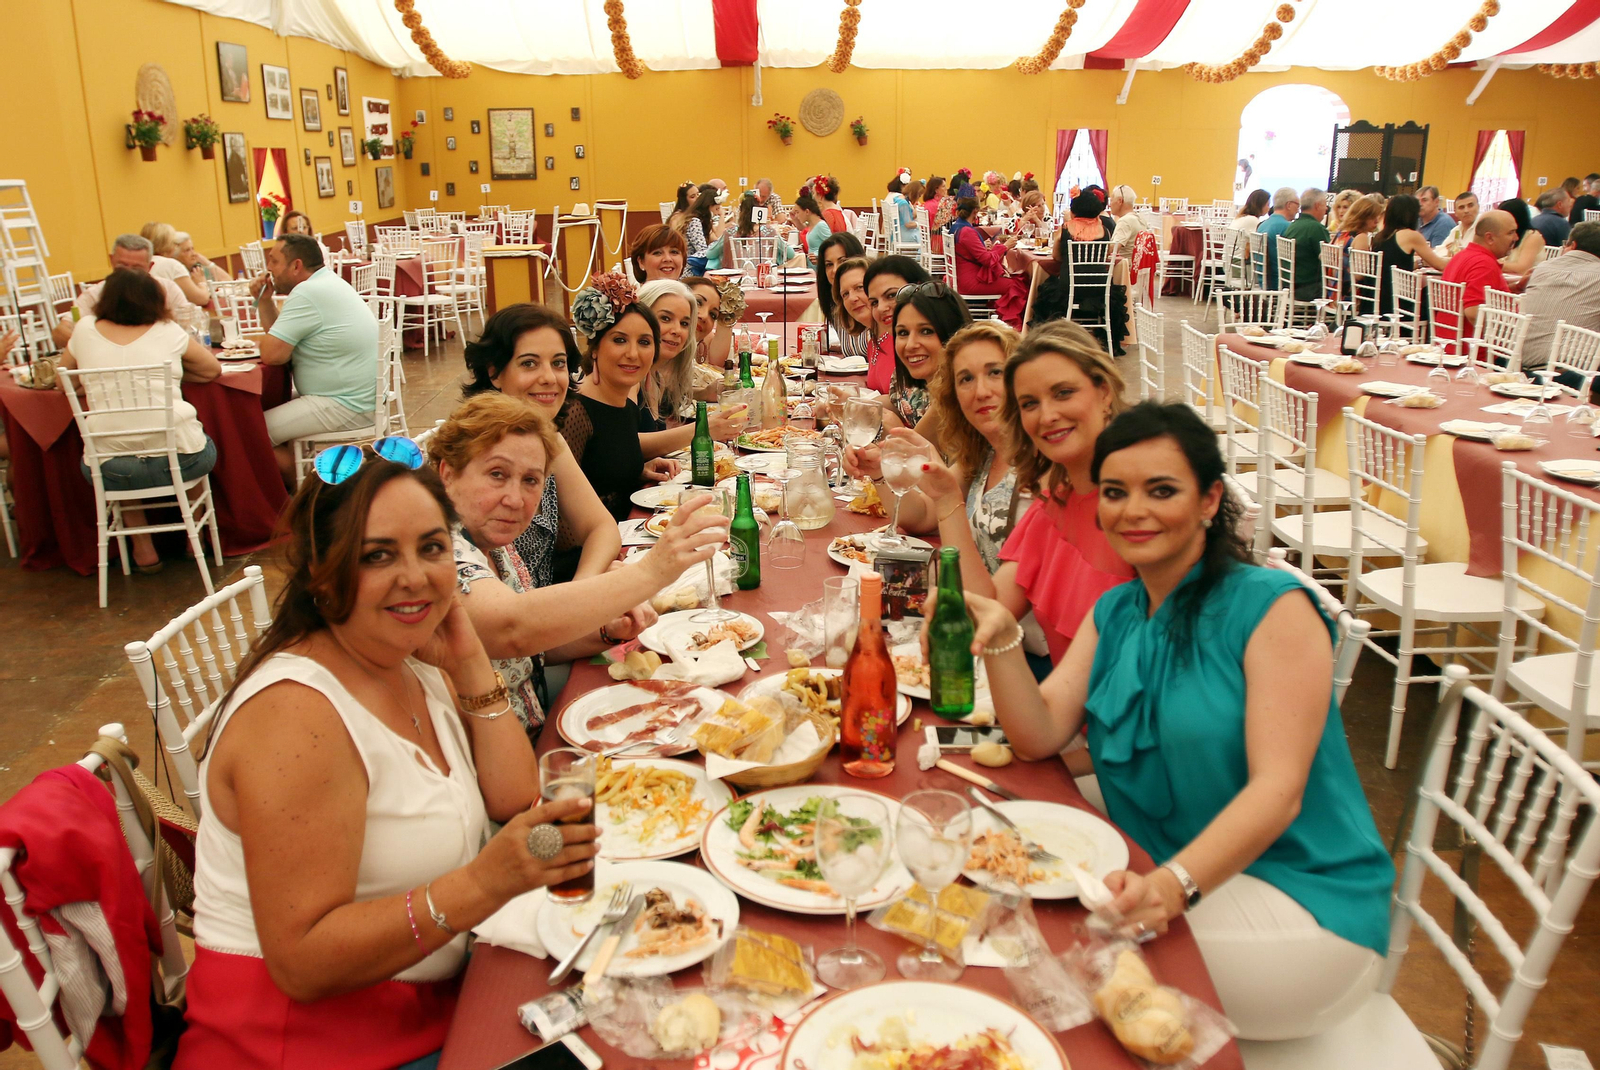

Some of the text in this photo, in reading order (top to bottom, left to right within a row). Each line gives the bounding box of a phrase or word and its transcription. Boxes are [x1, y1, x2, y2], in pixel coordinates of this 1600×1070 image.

[1055, 193, 1064, 202] 17
[1326, 194, 1335, 202] 22
[757, 210, 763, 221] 9
